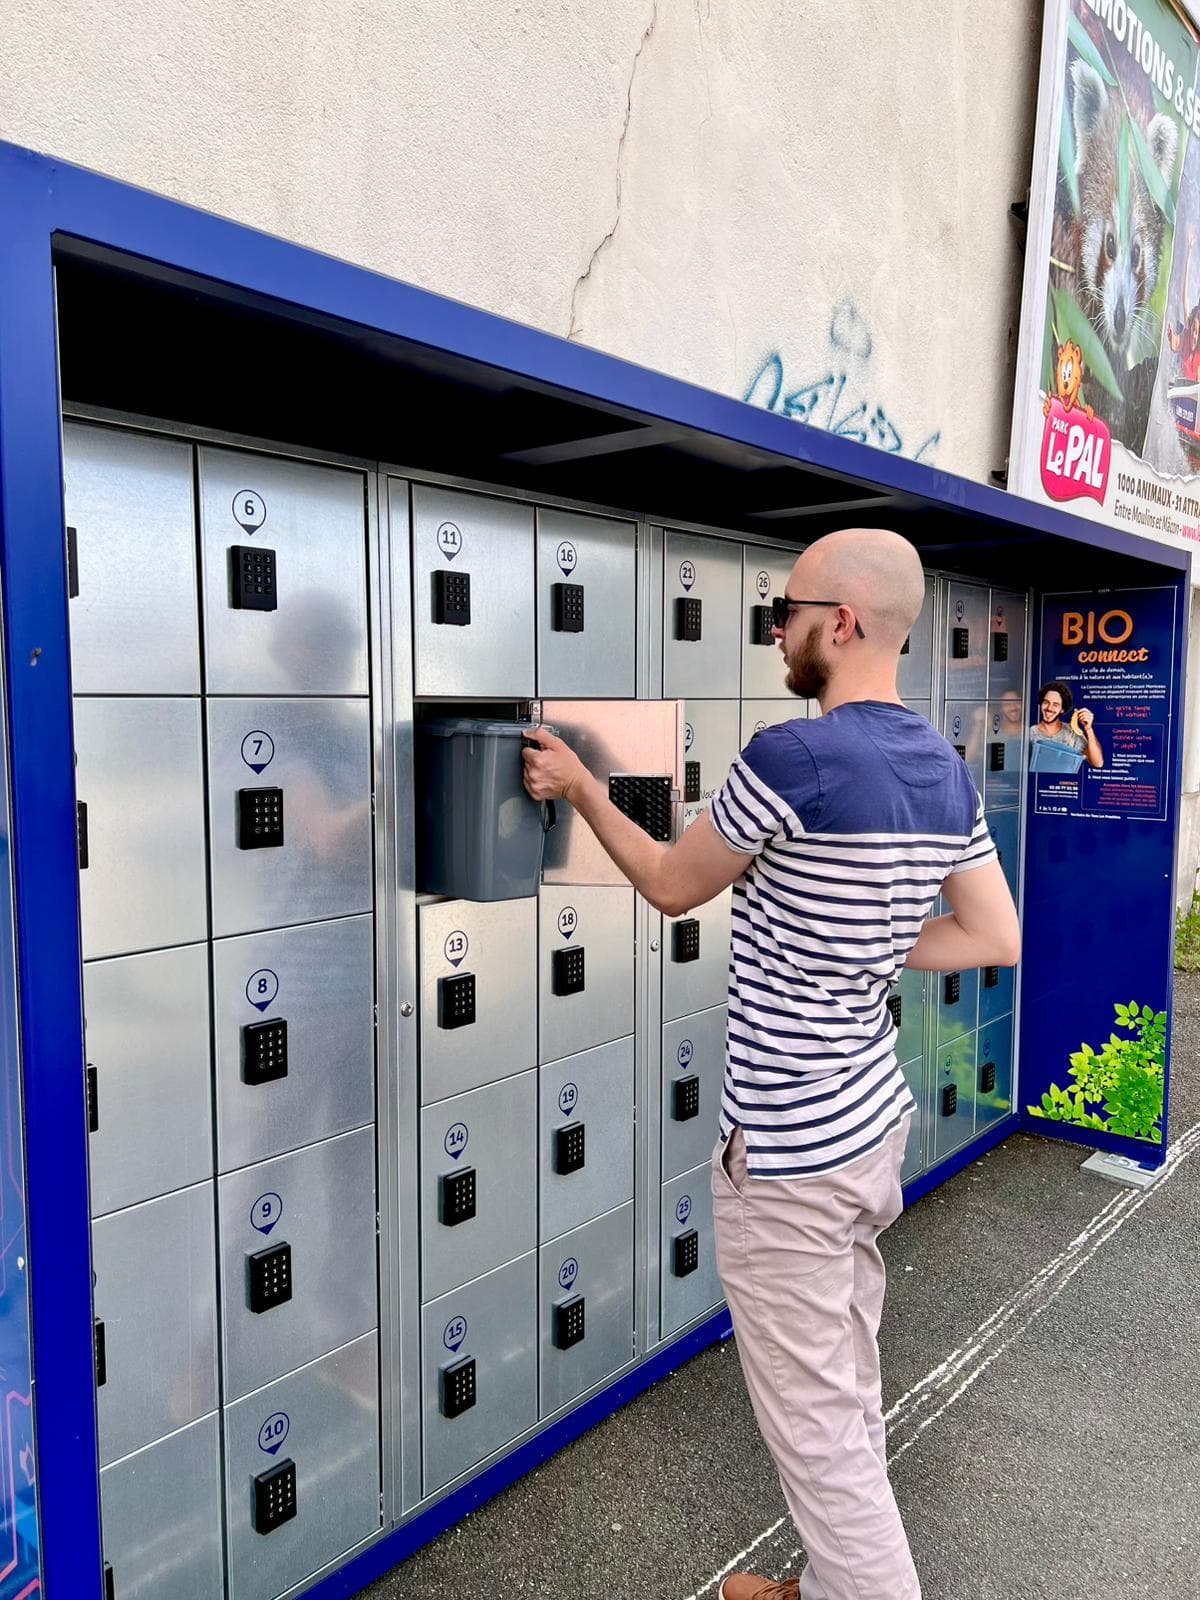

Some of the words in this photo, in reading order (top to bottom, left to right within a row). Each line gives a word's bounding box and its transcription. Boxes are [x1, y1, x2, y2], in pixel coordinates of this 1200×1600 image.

[1083, 0, 1175, 100] MOTIONS
[1174, 74, 1184, 117] &
[1051, 416, 1069, 434] PARC
[1117, 472, 1136, 495] 1000
[1135, 478, 1173, 509] ANIMAUX
[1174, 494, 1183, 513] 31
[244, 500, 255, 515] 6
[1114, 499, 1132, 521] Entre
[1131, 505, 1156, 529] Moulins
[1155, 516, 1163, 530] et
[442, 530, 458, 545] 11
[559, 549, 573, 562] 16
[682, 567, 693, 579] 21
[758, 577, 768, 588] 26
[1062, 609, 1134, 645] BIO
[1077, 647, 1149, 663] connect
[252, 740, 263, 755] 7
[561, 913, 574, 927] 18
[449, 938, 463, 953] 13
[259, 978, 268, 993] 8
[680, 1045, 690, 1058] 24
[561, 1089, 574, 1104] 19
[449, 1131, 464, 1146] 14
[261, 1202, 271, 1218] 9
[678, 1200, 688, 1212] 25
[562, 1263, 575, 1280] 20
[448, 1322, 461, 1340] 15
[265, 1419, 284, 1441] 10
